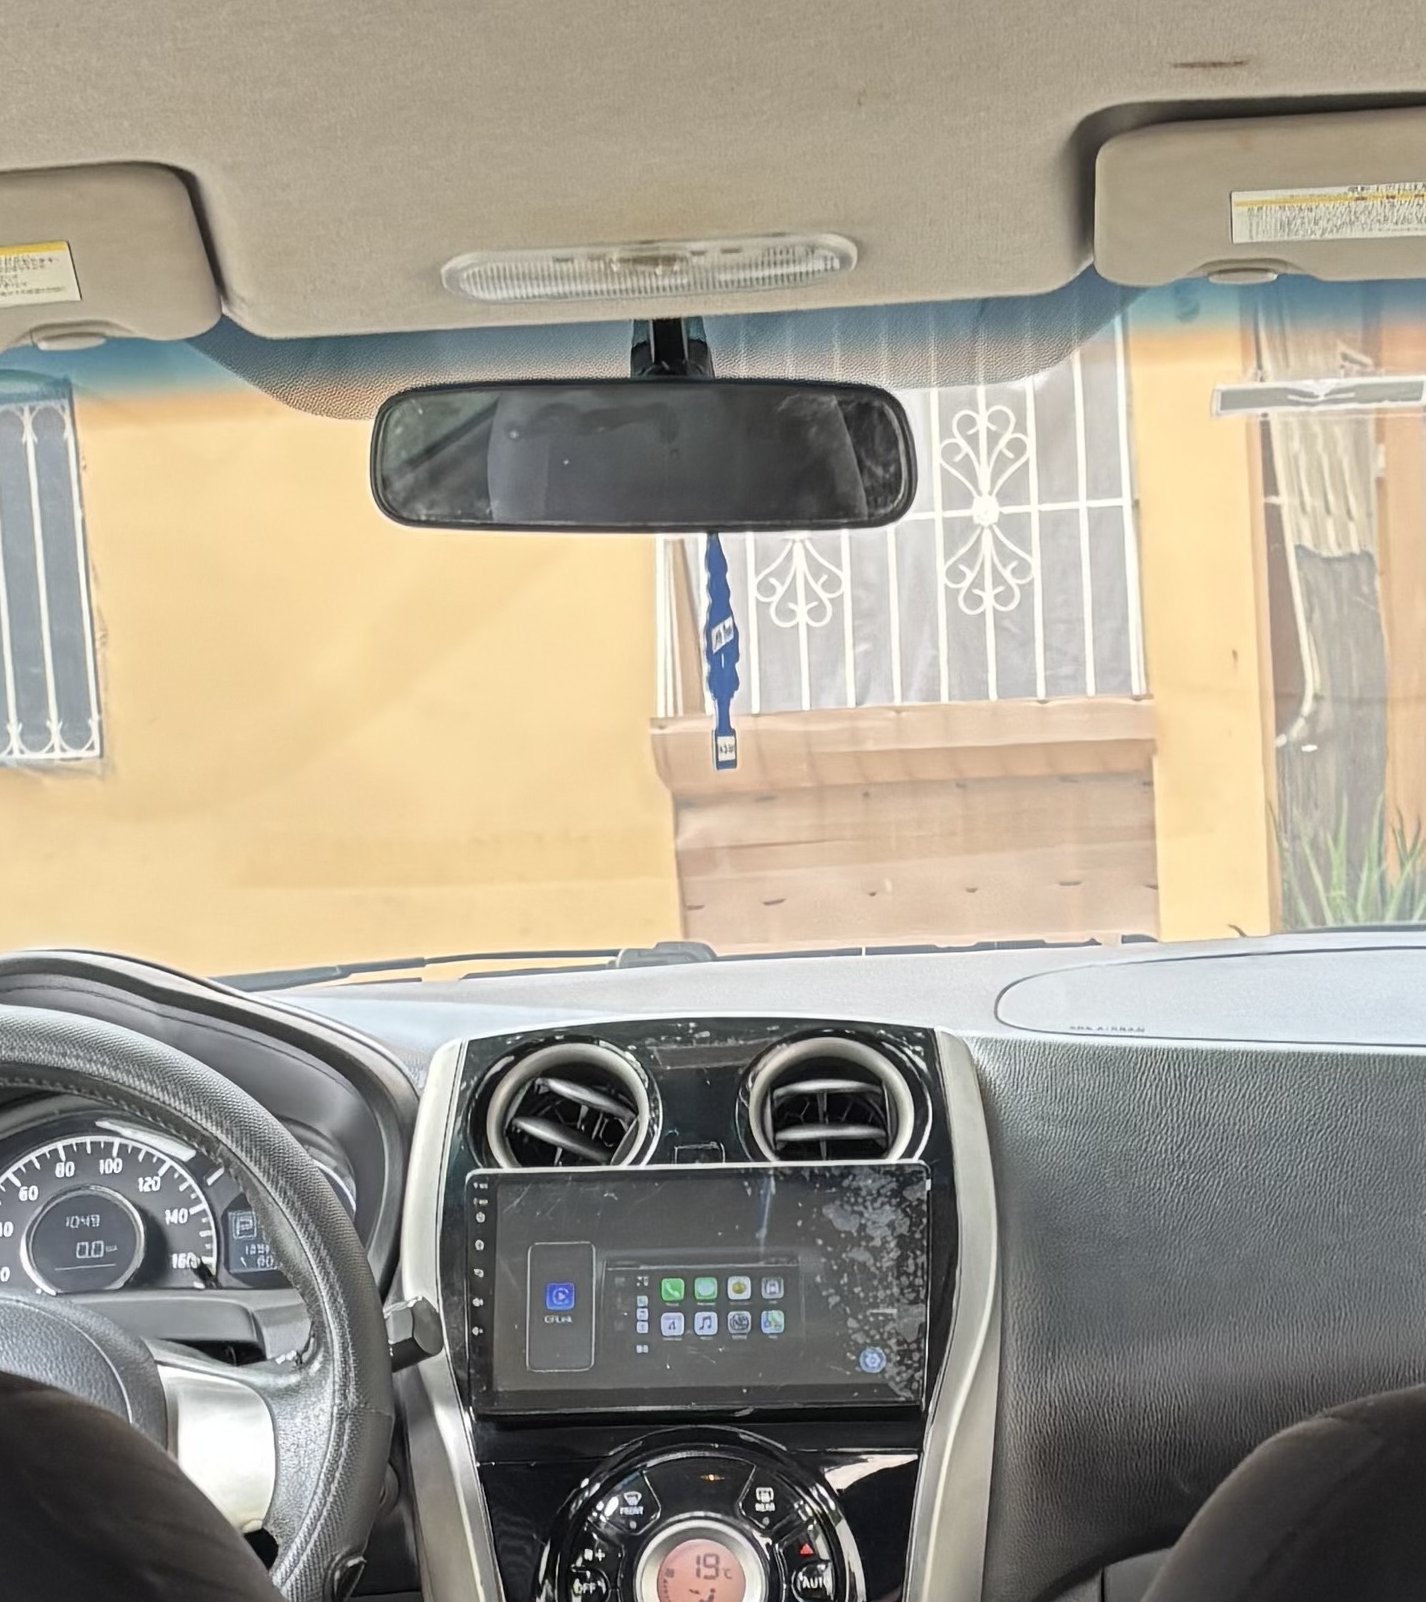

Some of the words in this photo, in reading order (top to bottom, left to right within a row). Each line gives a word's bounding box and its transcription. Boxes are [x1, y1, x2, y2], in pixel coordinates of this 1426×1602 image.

[55, 1161, 75, 1178] 80
[99, 1158, 123, 1174] 100
[138, 1175, 161, 1192] 120
[18, 1185, 39, 1201] 60
[165, 1208, 189, 1226] 140
[695, 1553, 720, 1580] 19
